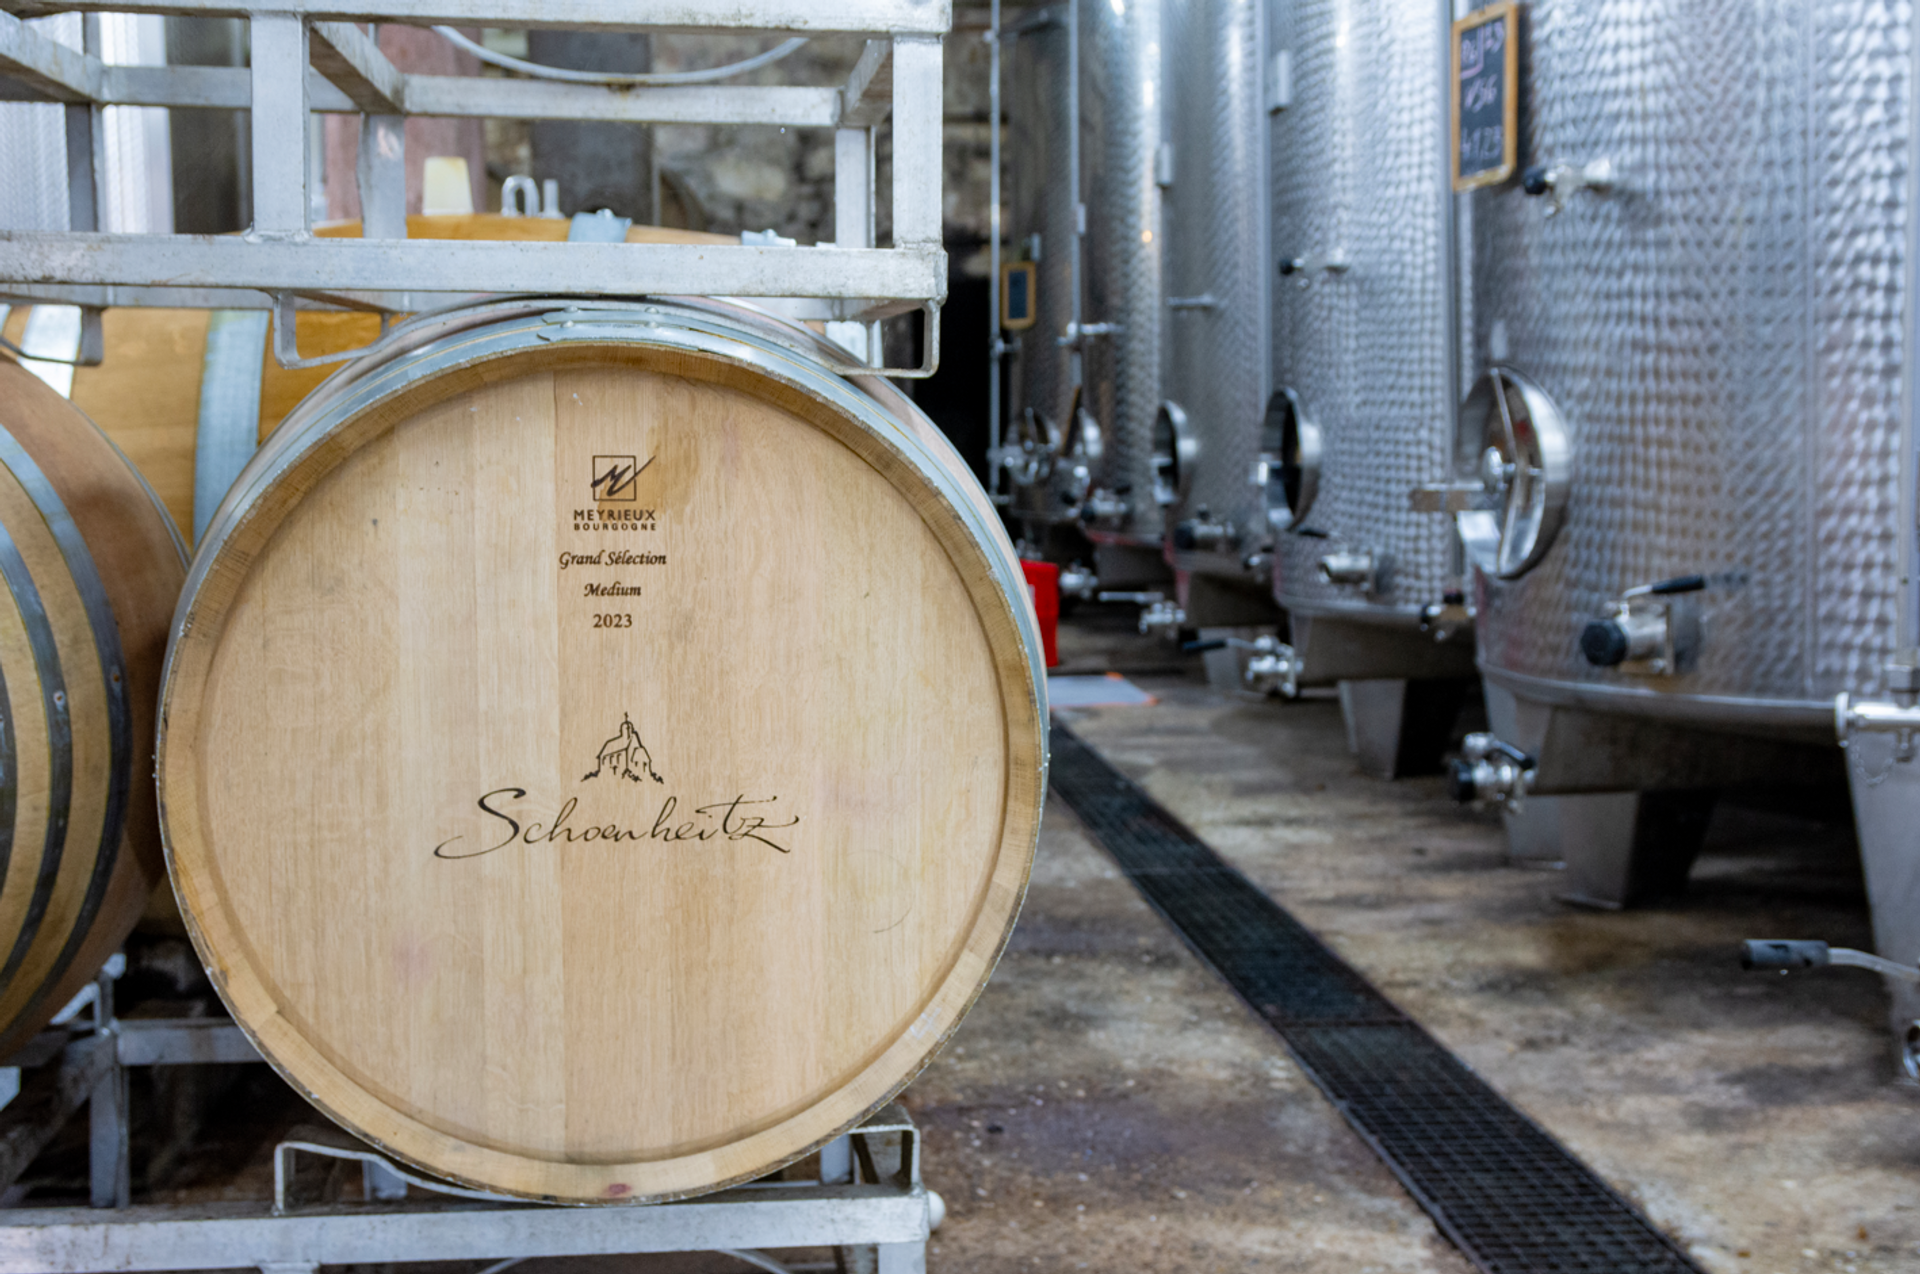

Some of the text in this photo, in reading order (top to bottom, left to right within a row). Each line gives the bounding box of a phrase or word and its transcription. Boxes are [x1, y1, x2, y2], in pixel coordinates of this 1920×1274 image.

[573, 509, 656, 521] MEYRIEUX
[573, 522, 657, 531] BOURGOGNE
[559, 549, 667, 569] Grand Sélection
[583, 581, 642, 597] Medium
[593, 613, 633, 628] 2023
[433, 787, 800, 860] Schoenheitz
